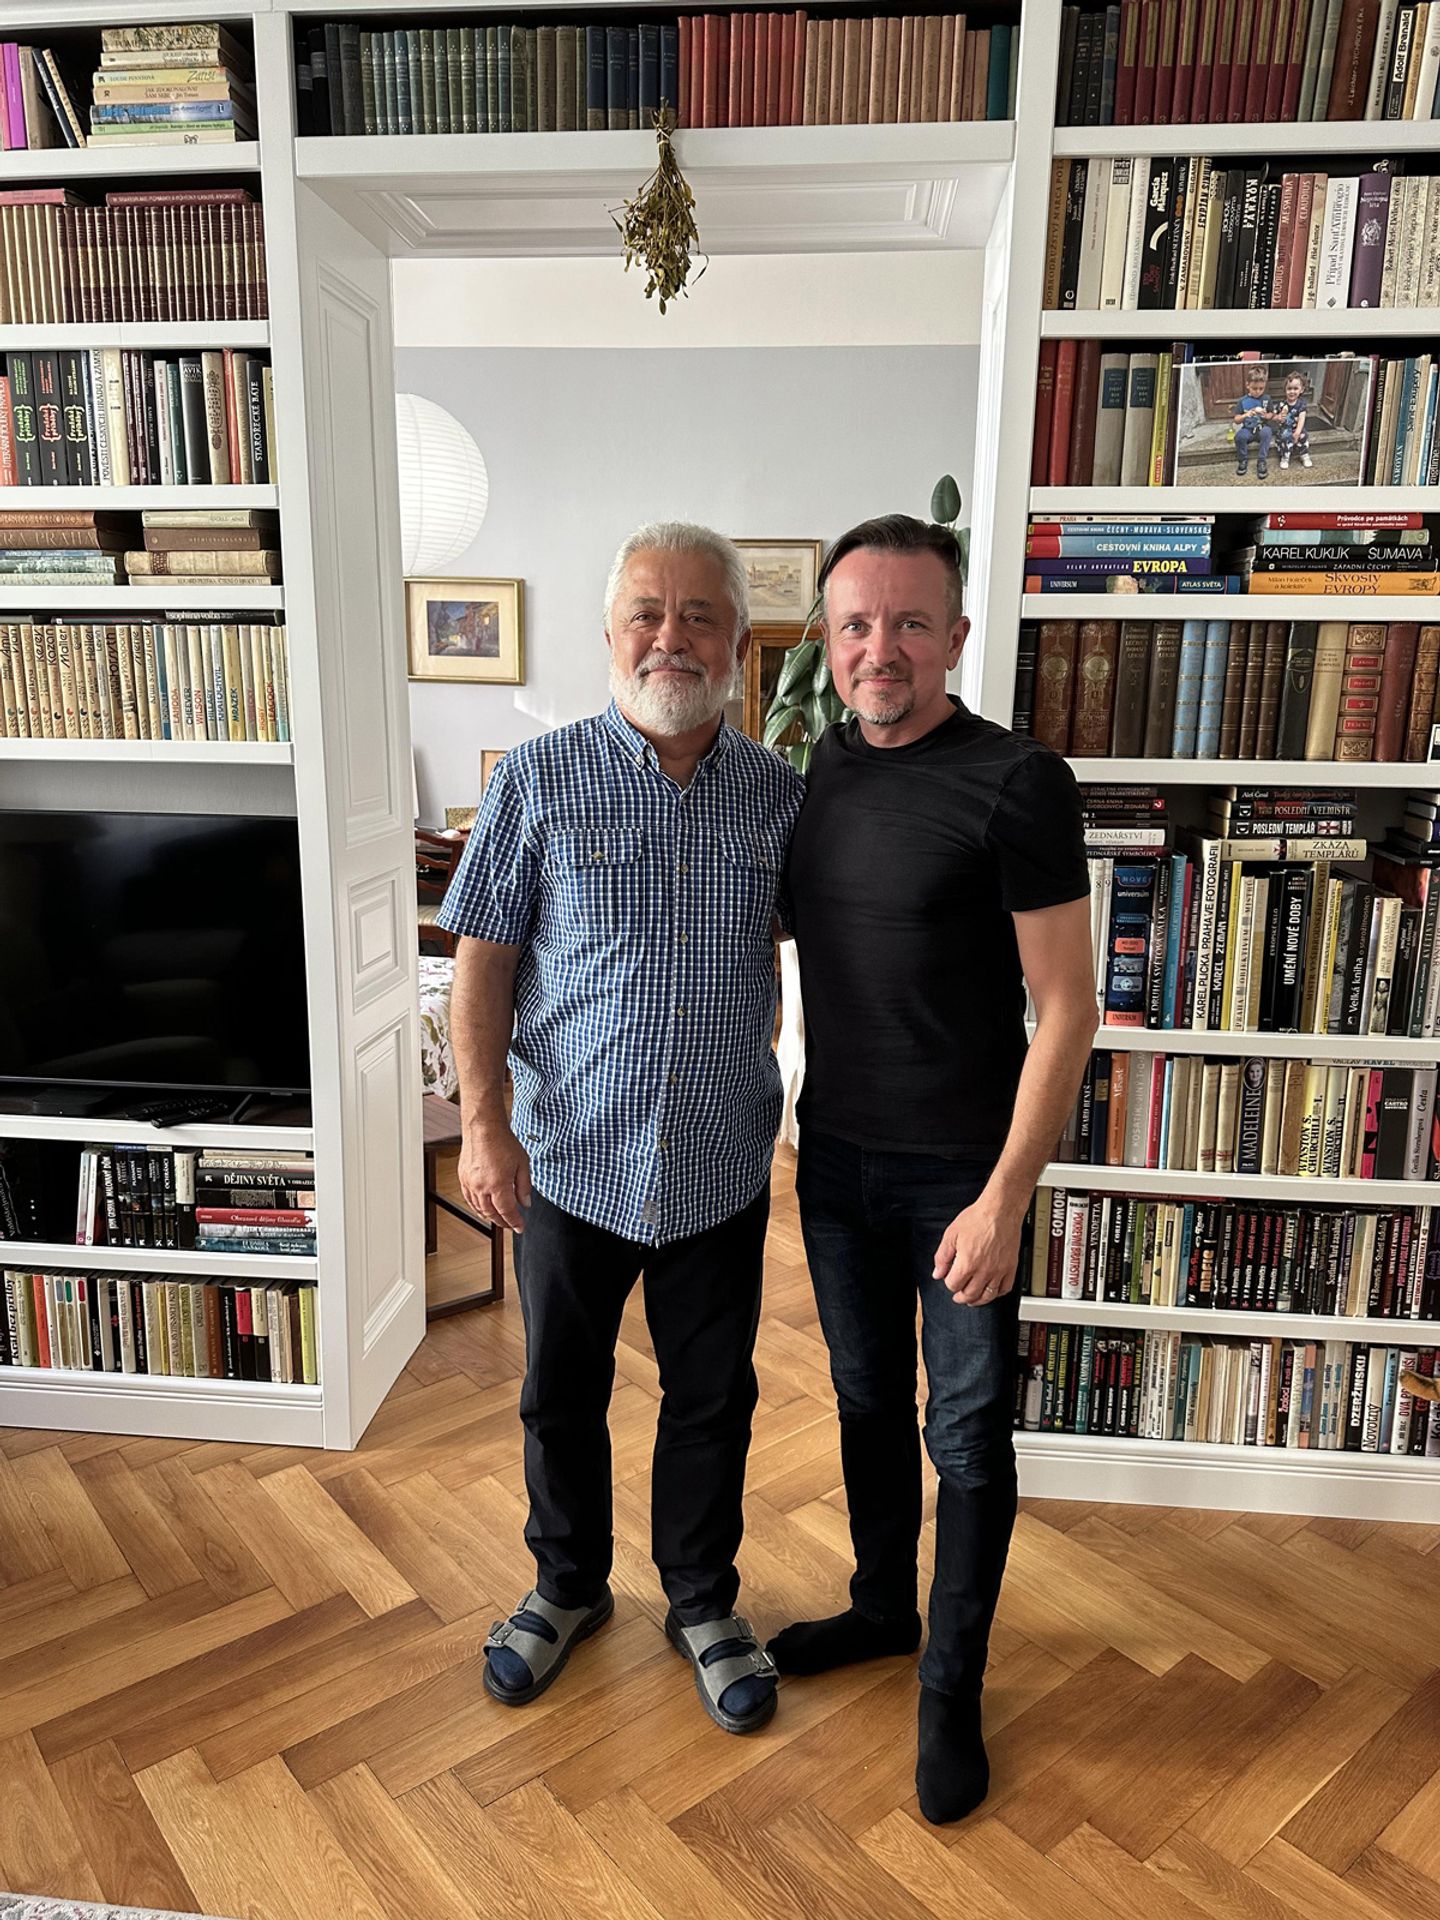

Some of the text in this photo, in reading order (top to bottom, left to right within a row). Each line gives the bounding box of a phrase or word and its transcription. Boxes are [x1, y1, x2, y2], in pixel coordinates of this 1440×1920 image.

[1395, 12, 1410, 80] Adolf Branald
[1150, 171, 1169, 212] García Márquez
[1300, 180, 1311, 220] CLAUDIUS
[1046, 186, 1062, 305] DOBRODRUŽSTVÍ MARCA
[1385, 246, 1395, 271] Robert
[1272, 264, 1285, 303] CLAUDIUS
[1325, 254, 1338, 285] Případ
[1393, 444, 1403, 484] SAROYAN
[1430, 449, 1440, 484] ragtime
[1376, 514, 1408, 522] památkách
[1096, 543, 1197, 552] CESTOVNÍ KNIHA ALPY
[1262, 547, 1350, 560] KAREL KUKLÍK
[1132, 560, 1187, 573] EVROPA
[1333, 561, 1392, 571] ZÁPADNÍ ČECHY
[1050, 580, 1078, 588] UNIVERSUM
[1202, 580, 1221, 588] SVĚTA
[1323, 584, 1381, 595] EVROPY
[10, 628, 19, 653] Vian
[33, 628, 45, 662] Kesey
[45, 628, 57, 666] Kazan
[85, 628, 96, 662] Heller
[95, 630, 103, 652] Levin
[184, 687, 194, 725] CHEEVER
[194, 689, 204, 725] WILSON
[266, 681, 276, 722] LEACOCK
[1274, 804, 1350, 815] POSLEDNÍ VELMISTR
[1089, 831, 1143, 839] ZEDNÁŘSTVÍ
[1252, 821, 1315, 834] POSLEDNÍ TEMPLÁŘ
[1313, 839, 1349, 850] ZKÁZA
[1117, 890, 1149, 898] universum
[1195, 845, 1219, 1019] KAREL PLICKA PRAHA VE FOTOGRAFII
[1357, 895, 1371, 949] starožitnostech
[1212, 921, 1227, 991] KAREL ZEMAN
[1283, 897, 1302, 985] UMĚNÍ NOVÉ DOBY
[1151, 907, 1167, 1011] DRUHÁ SVĚTOVÁ VÁLKA
[1351, 957, 1364, 984] kniha
[1235, 999, 1244, 1027] PRAHA
[1348, 986, 1360, 1013] Velká
[1416, 1089, 1428, 1112] Cesta
[1241, 1089, 1261, 1159] MADELEINE
[1298, 1127, 1311, 1173] WINSTON
[1307, 1115, 1322, 1173] CHURCHILL
[1322, 1116, 1337, 1174] WINSTON S.
[224, 1172, 286, 1186] DĚJINY SVĚTA
[1089, 1202, 1101, 1246] VENDETTA
[1113, 1206, 1122, 1243] CORLEONE
[1328, 1244, 1339, 1258] Yard
[1417, 1242, 1427, 1274] DETEKTIVKA
[1326, 1260, 1337, 1285] Scotland
[1405, 1239, 1418, 1304] HISTORICKÁ DETEKTIVKA
[1414, 1274, 1423, 1306] HISTORICKÁ
[1398, 1401, 1411, 1416] DVA
[1362, 1403, 1382, 1449] Novotný
